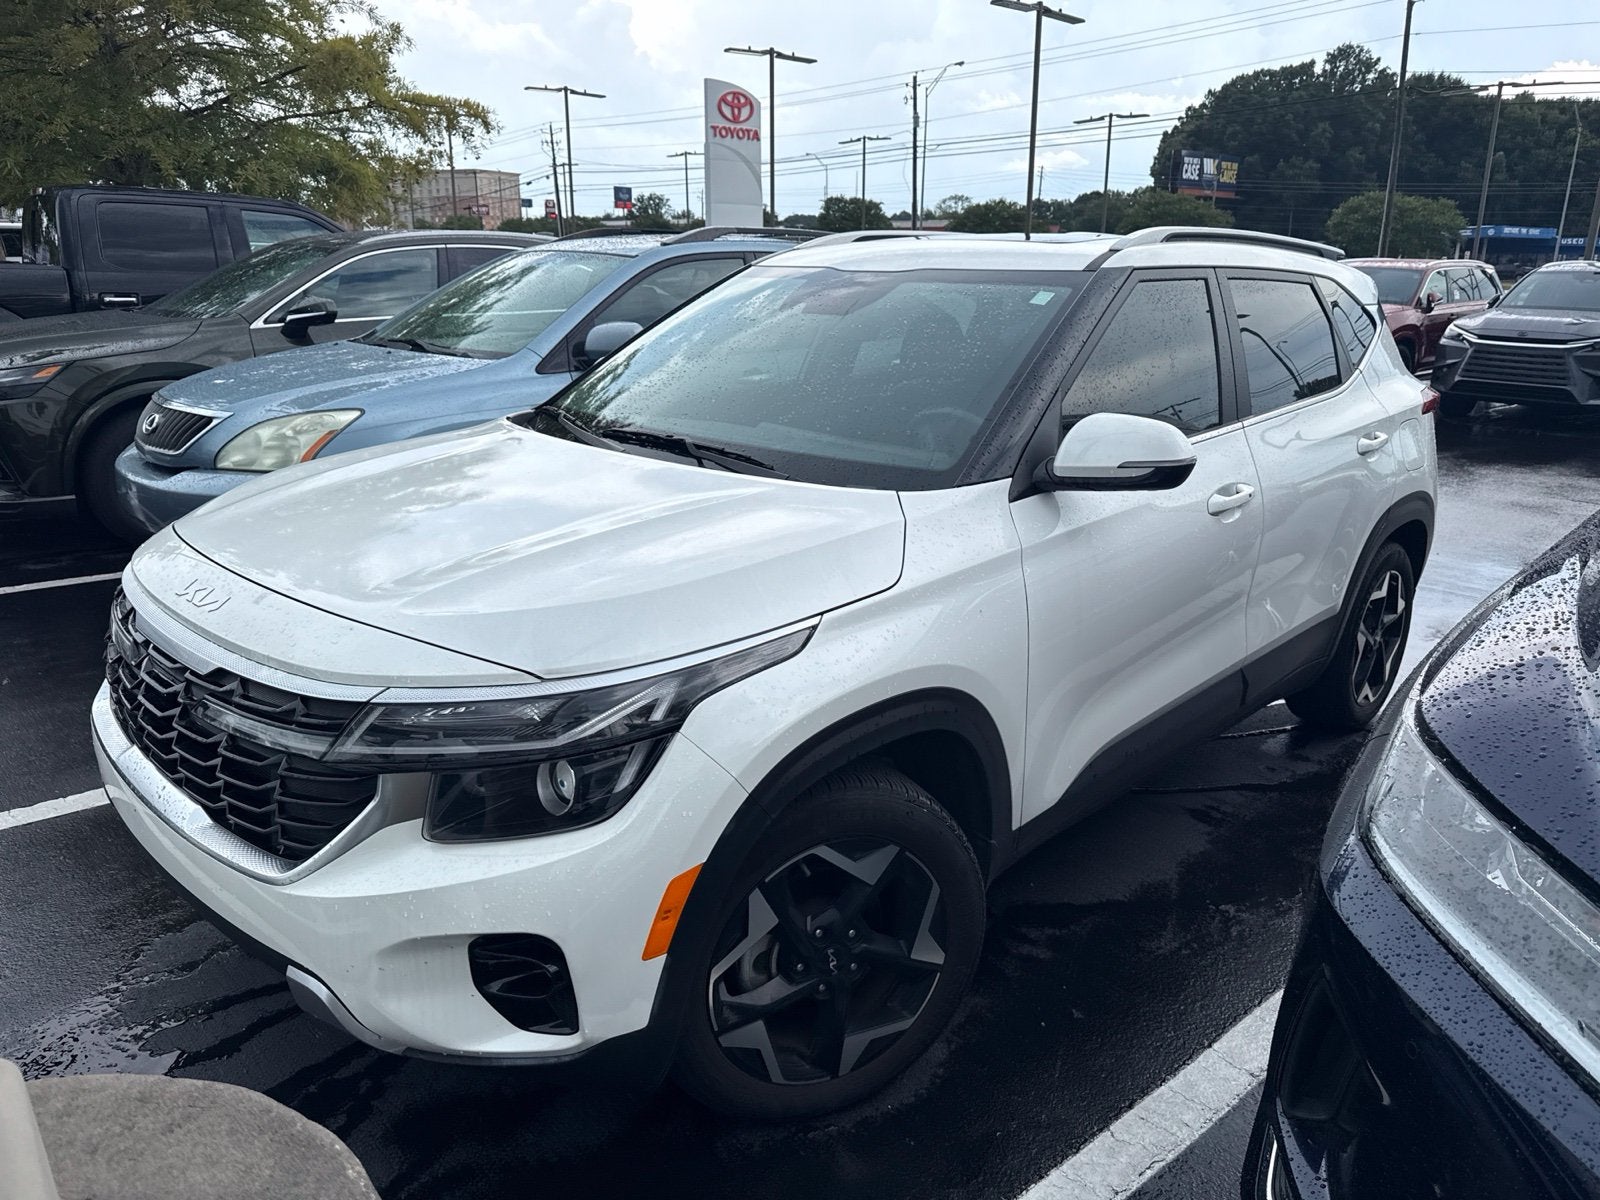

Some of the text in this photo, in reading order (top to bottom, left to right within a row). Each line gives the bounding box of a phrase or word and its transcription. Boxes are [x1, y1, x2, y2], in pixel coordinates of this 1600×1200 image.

[710, 125, 760, 142] TOYOTA
[1182, 163, 1200, 180] CASE
[1561, 237, 1584, 245] USED
